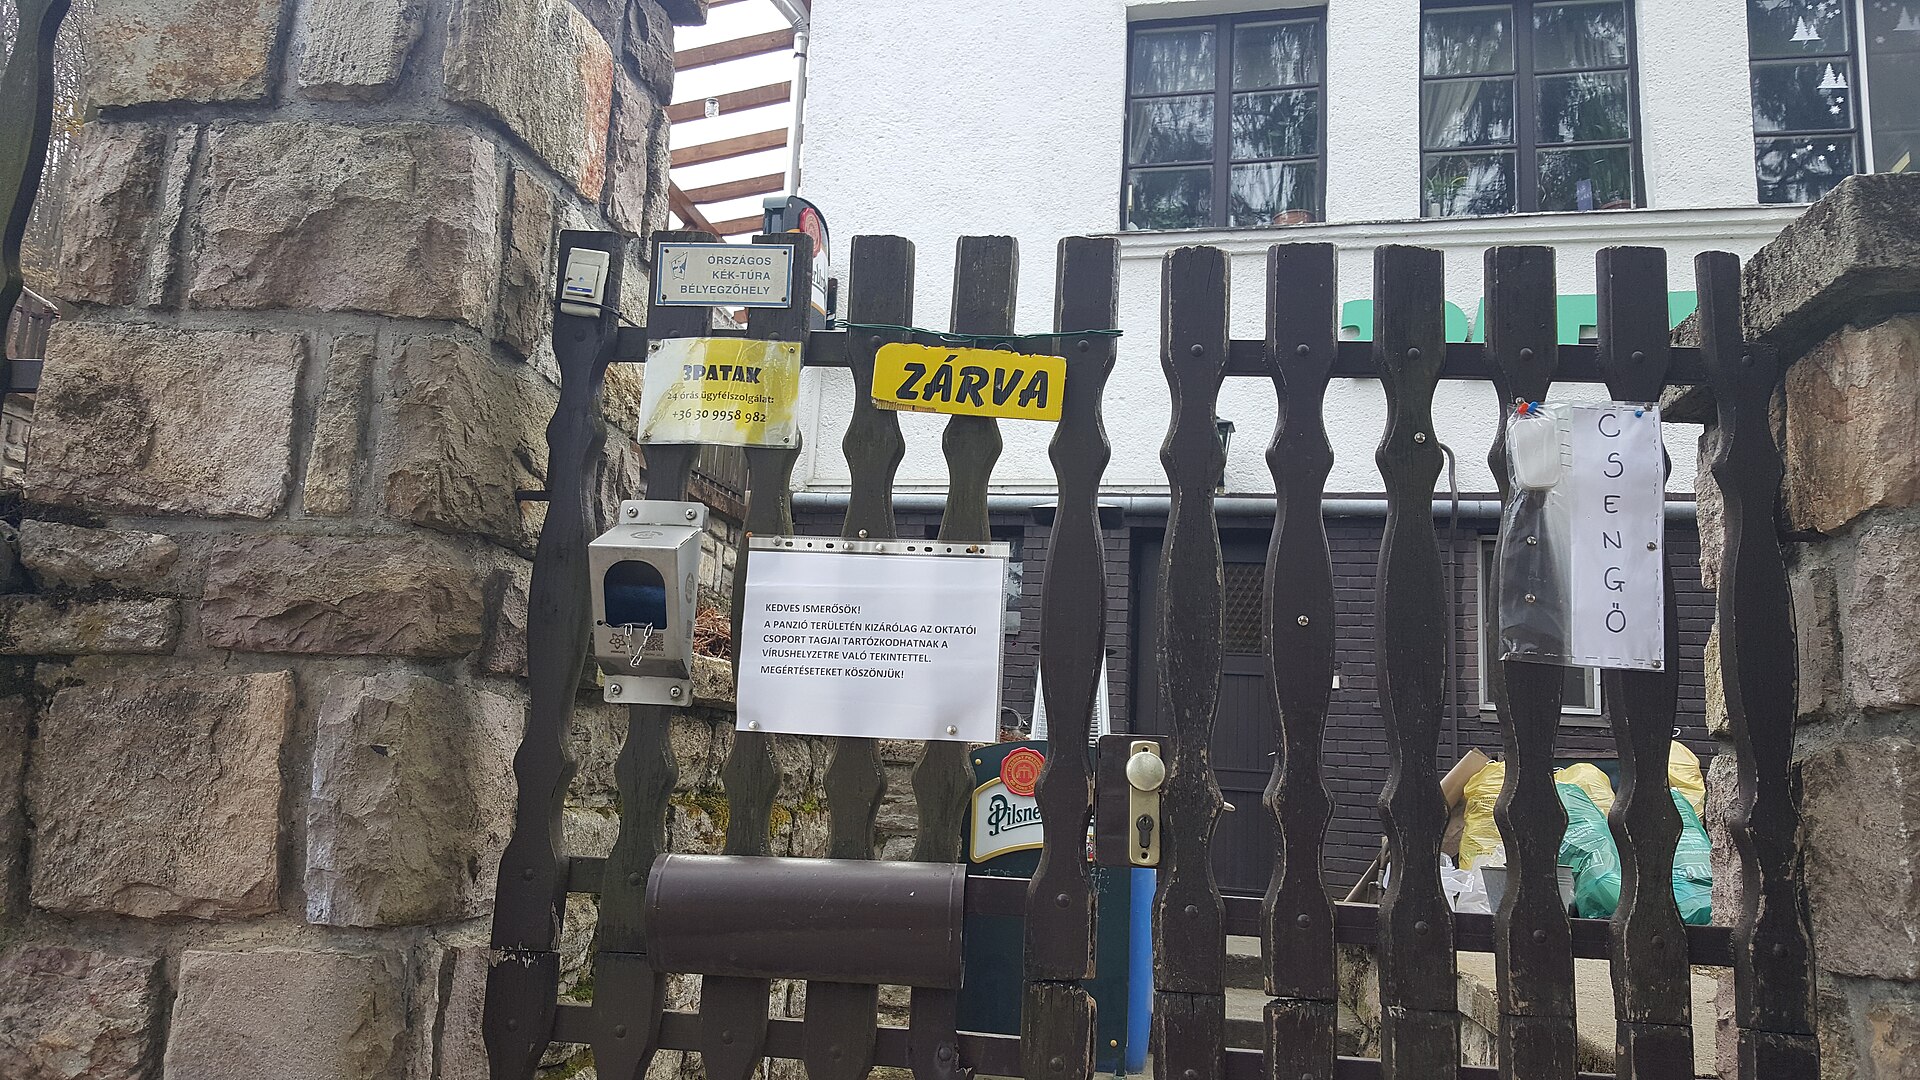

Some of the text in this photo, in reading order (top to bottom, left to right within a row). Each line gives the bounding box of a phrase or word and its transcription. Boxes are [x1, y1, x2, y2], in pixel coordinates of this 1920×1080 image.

[707, 254, 772, 266] ORSZÁGOS
[712, 269, 771, 280] KÉK-TÚRA
[680, 283, 770, 295] BÉLYEGZŐHELY
[683, 364, 762, 384] 3PATAK
[896, 355, 1049, 409] ZÁRVA
[680, 391, 699, 399] órás
[701, 391, 775, 404] ügyfélszolgálat:
[672, 408, 767, 424] +36 30 9958 982
[765, 603, 861, 615] KEDVES ISMERŐSÖK!
[773, 619, 808, 630] PANZIÓ
[810, 620, 862, 631] TERÜLETÉN
[864, 622, 918, 633] KIZÁRÓLAG
[919, 626, 932, 634] AZ
[935, 624, 977, 635] OKTATÓI
[763, 635, 948, 649] CSOPORT TAGJAI TARTÓZKODHATNAK A
[762, 648, 932, 663] VÍRUSHELYZETRE VALÓ TEKINTETTEL.
[760, 665, 904, 679] MEGÉRTÉSETEKET KÖSZÖNJÜK!
[988, 793, 1043, 836] Pilsne
